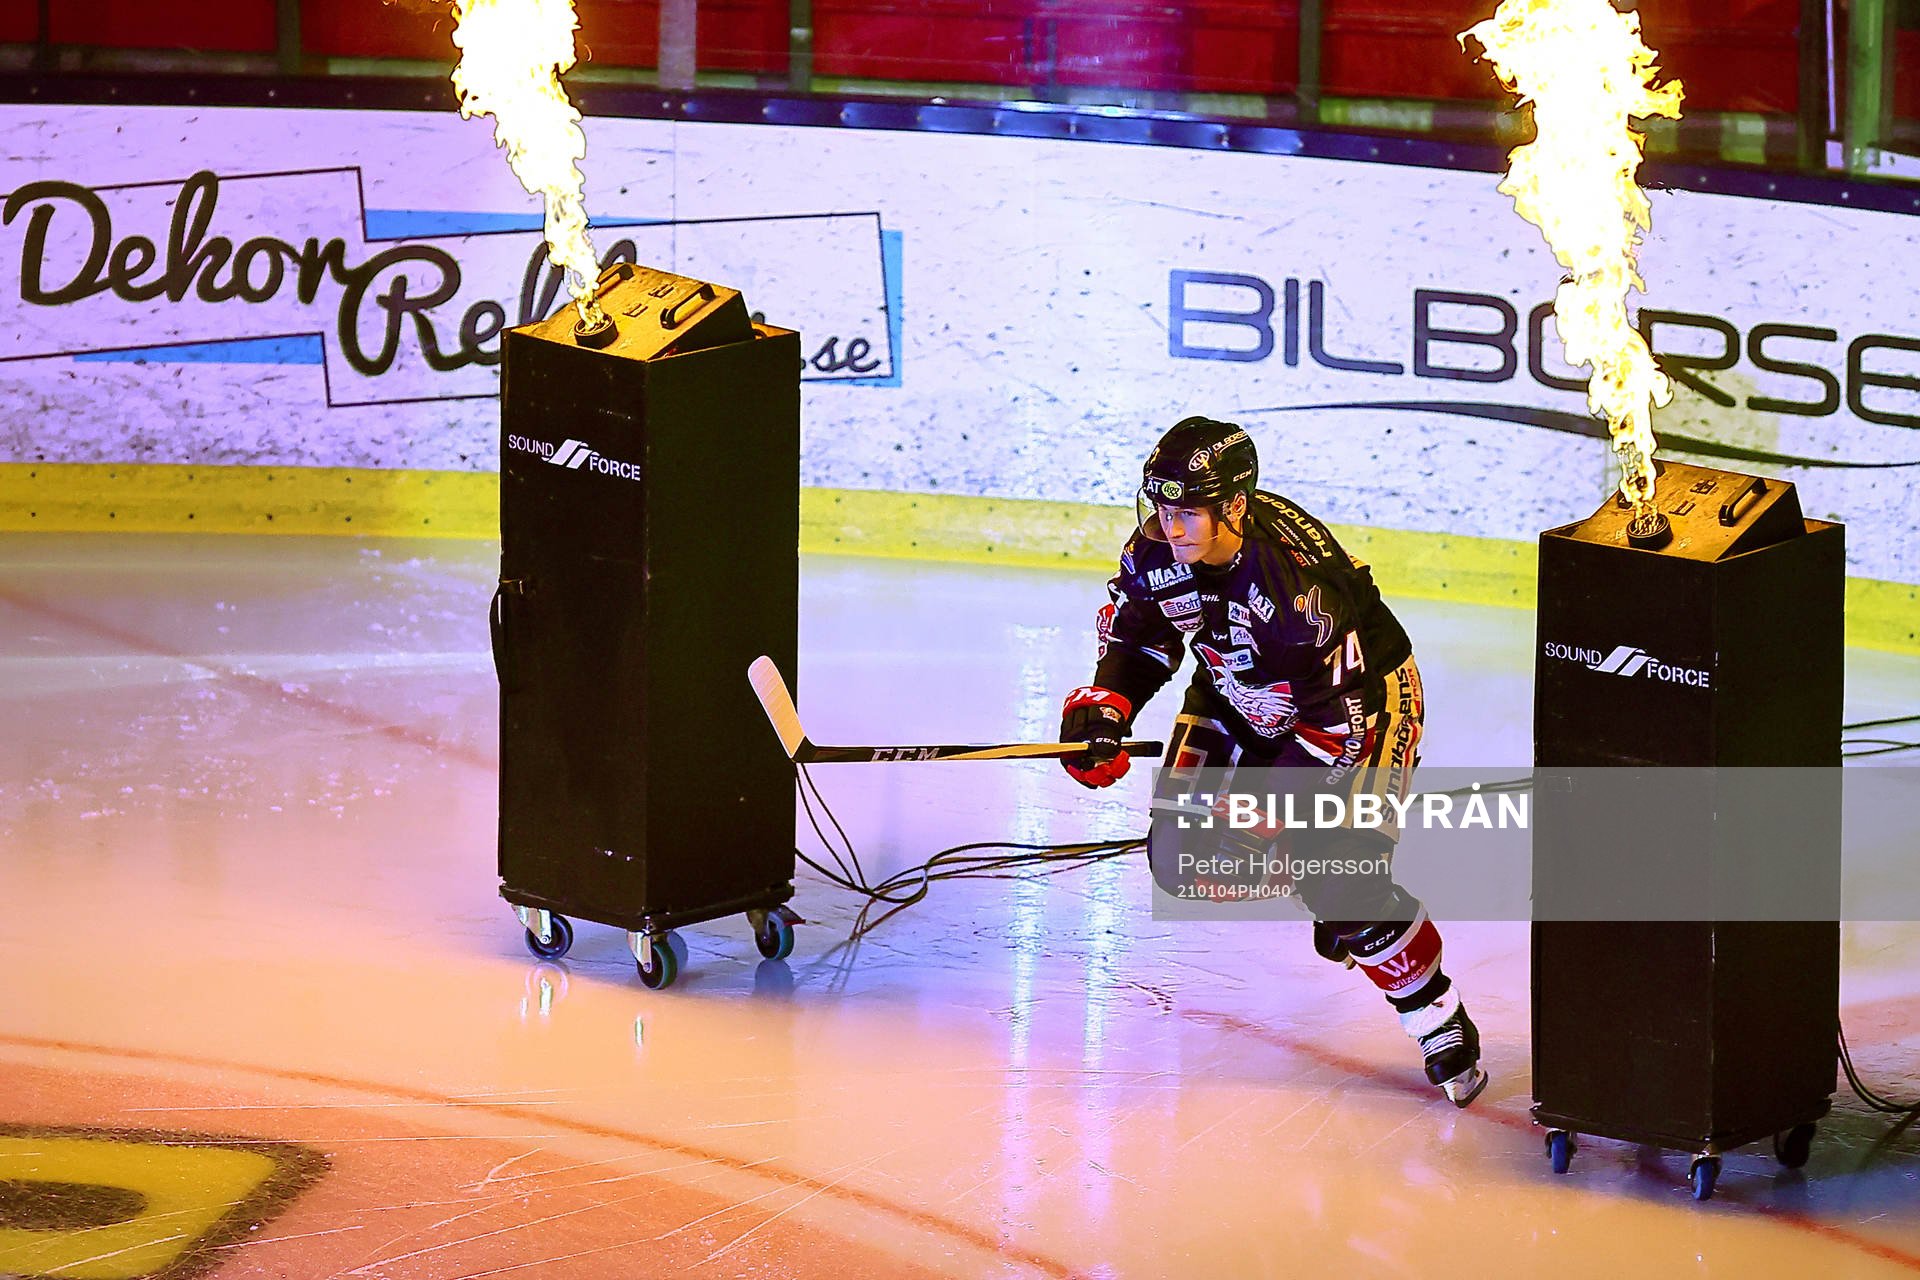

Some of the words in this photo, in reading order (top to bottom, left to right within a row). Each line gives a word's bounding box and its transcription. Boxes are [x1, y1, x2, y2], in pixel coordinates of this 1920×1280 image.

[3, 170, 350, 306] Dekor
[508, 434, 555, 458] SOUND
[589, 453, 641, 482] FORCE
[1201, 594, 1220, 602] SHL
[1323, 630, 1366, 687] 74
[1545, 641, 1602, 665] SOUND
[1647, 662, 1710, 688] FORCE
[871, 747, 940, 761] CCM
[1364, 929, 1396, 951] CCM
